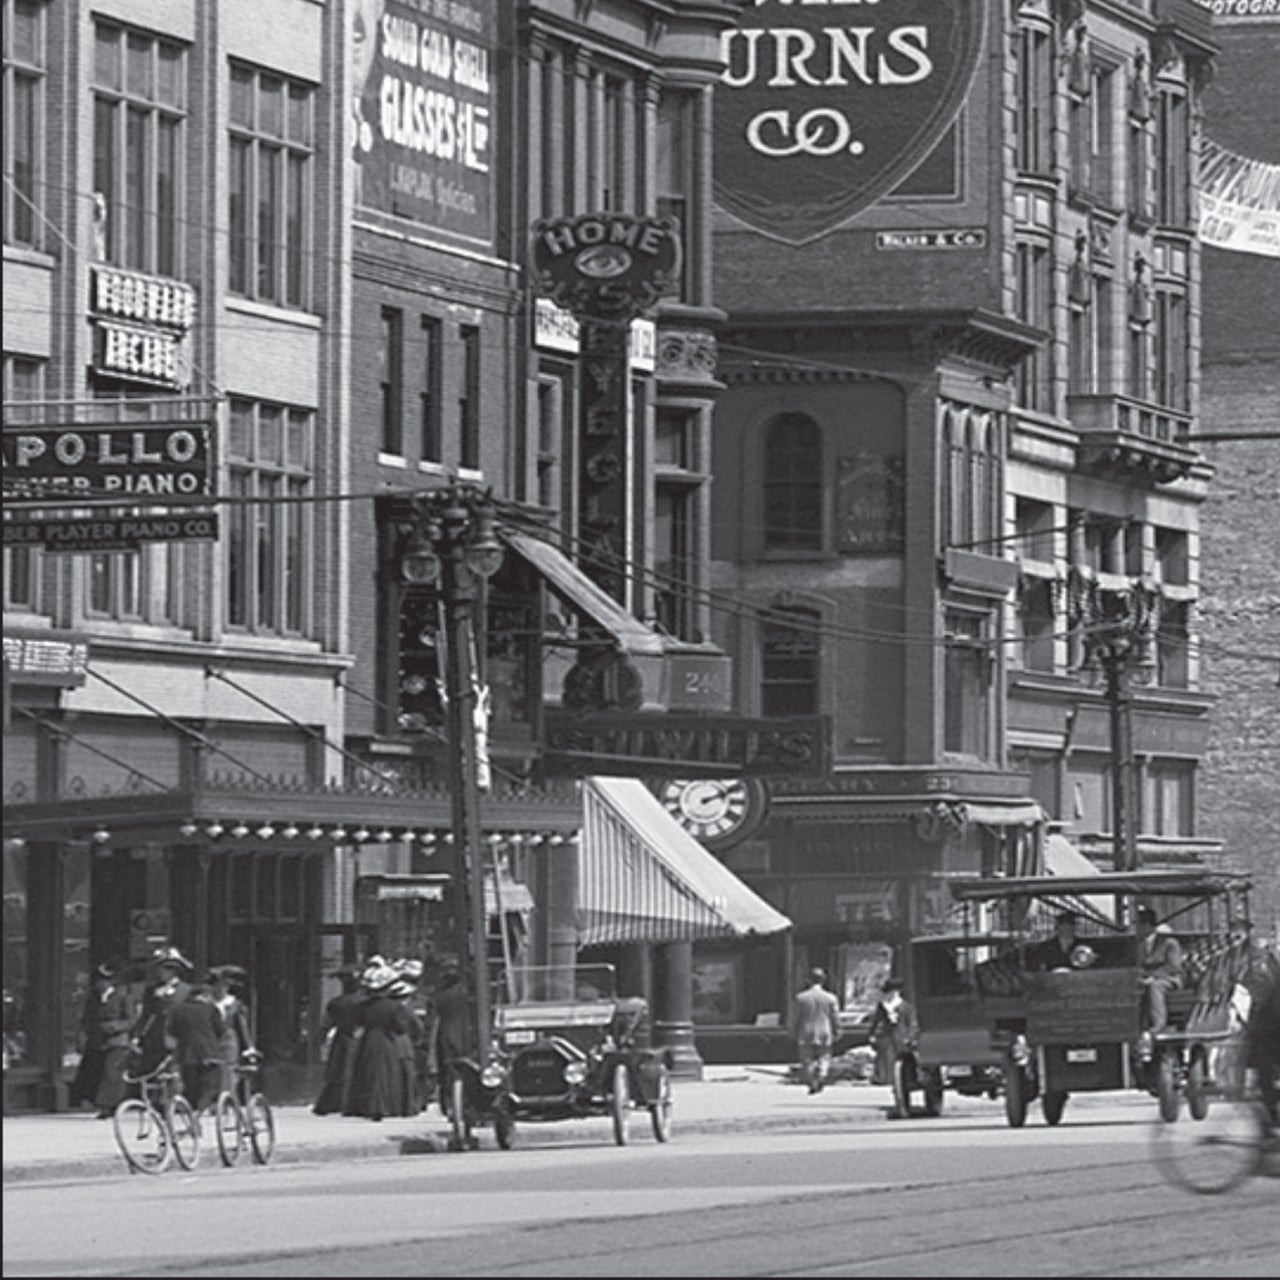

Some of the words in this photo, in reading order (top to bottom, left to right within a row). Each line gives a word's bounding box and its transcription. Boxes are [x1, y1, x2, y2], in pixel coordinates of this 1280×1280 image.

[747, 108, 864, 156] CO.
[545, 222, 664, 255] HOME
[2, 431, 196, 468] POLLO
[103, 473, 198, 494] PIANO
